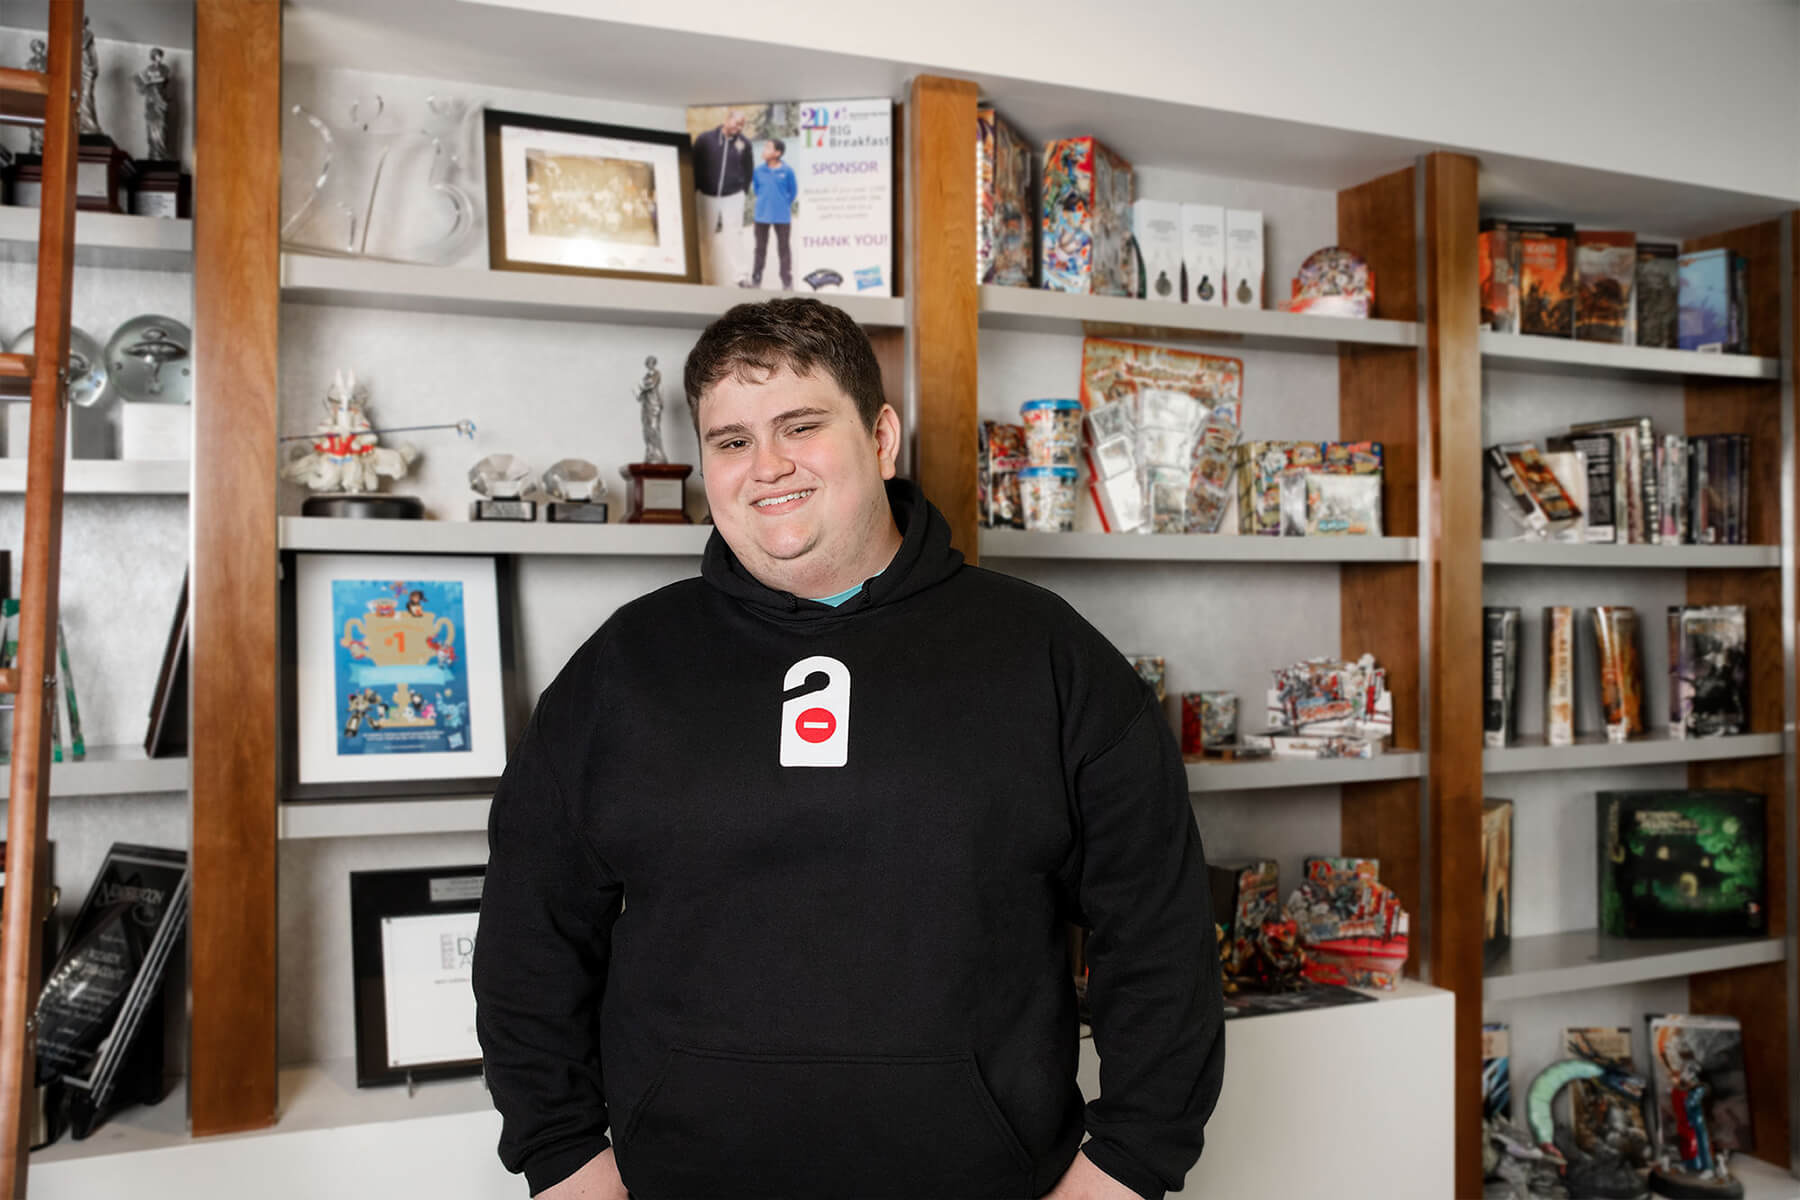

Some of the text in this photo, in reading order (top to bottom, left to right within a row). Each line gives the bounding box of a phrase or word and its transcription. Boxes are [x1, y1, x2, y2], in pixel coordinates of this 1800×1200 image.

[829, 136, 891, 148] Breakfast
[812, 160, 879, 175] SPONSOR
[802, 233, 888, 249] THANK YOU!
